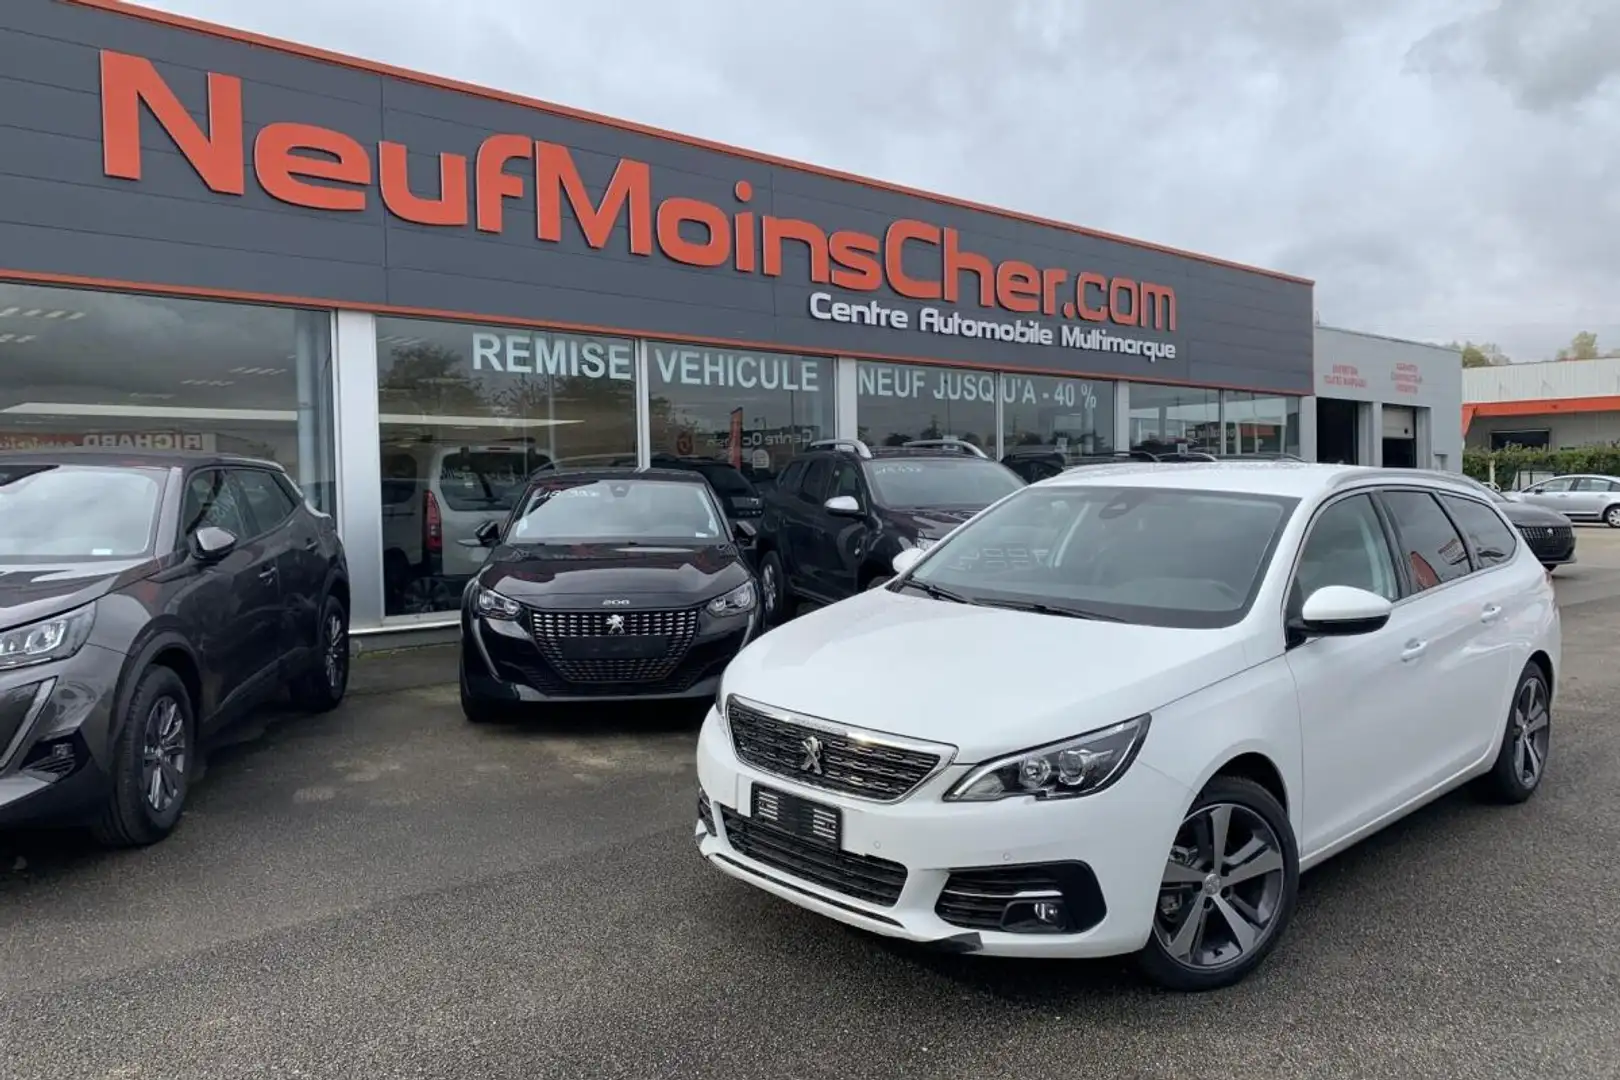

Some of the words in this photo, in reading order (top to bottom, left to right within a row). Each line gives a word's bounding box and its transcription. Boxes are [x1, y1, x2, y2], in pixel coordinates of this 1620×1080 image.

[100, 49, 1177, 332] NeufMoinsCher.com
[809, 291, 909, 329] Centre
[919, 307, 1054, 346] Automobile
[1060, 325, 1177, 362] Multimarque
[472, 332, 632, 380] REMISE
[655, 349, 820, 391] VEHICULE
[857, 365, 926, 398] NEUF
[1054, 381, 1075, 407] 40
[1081, 383, 1097, 409] %
